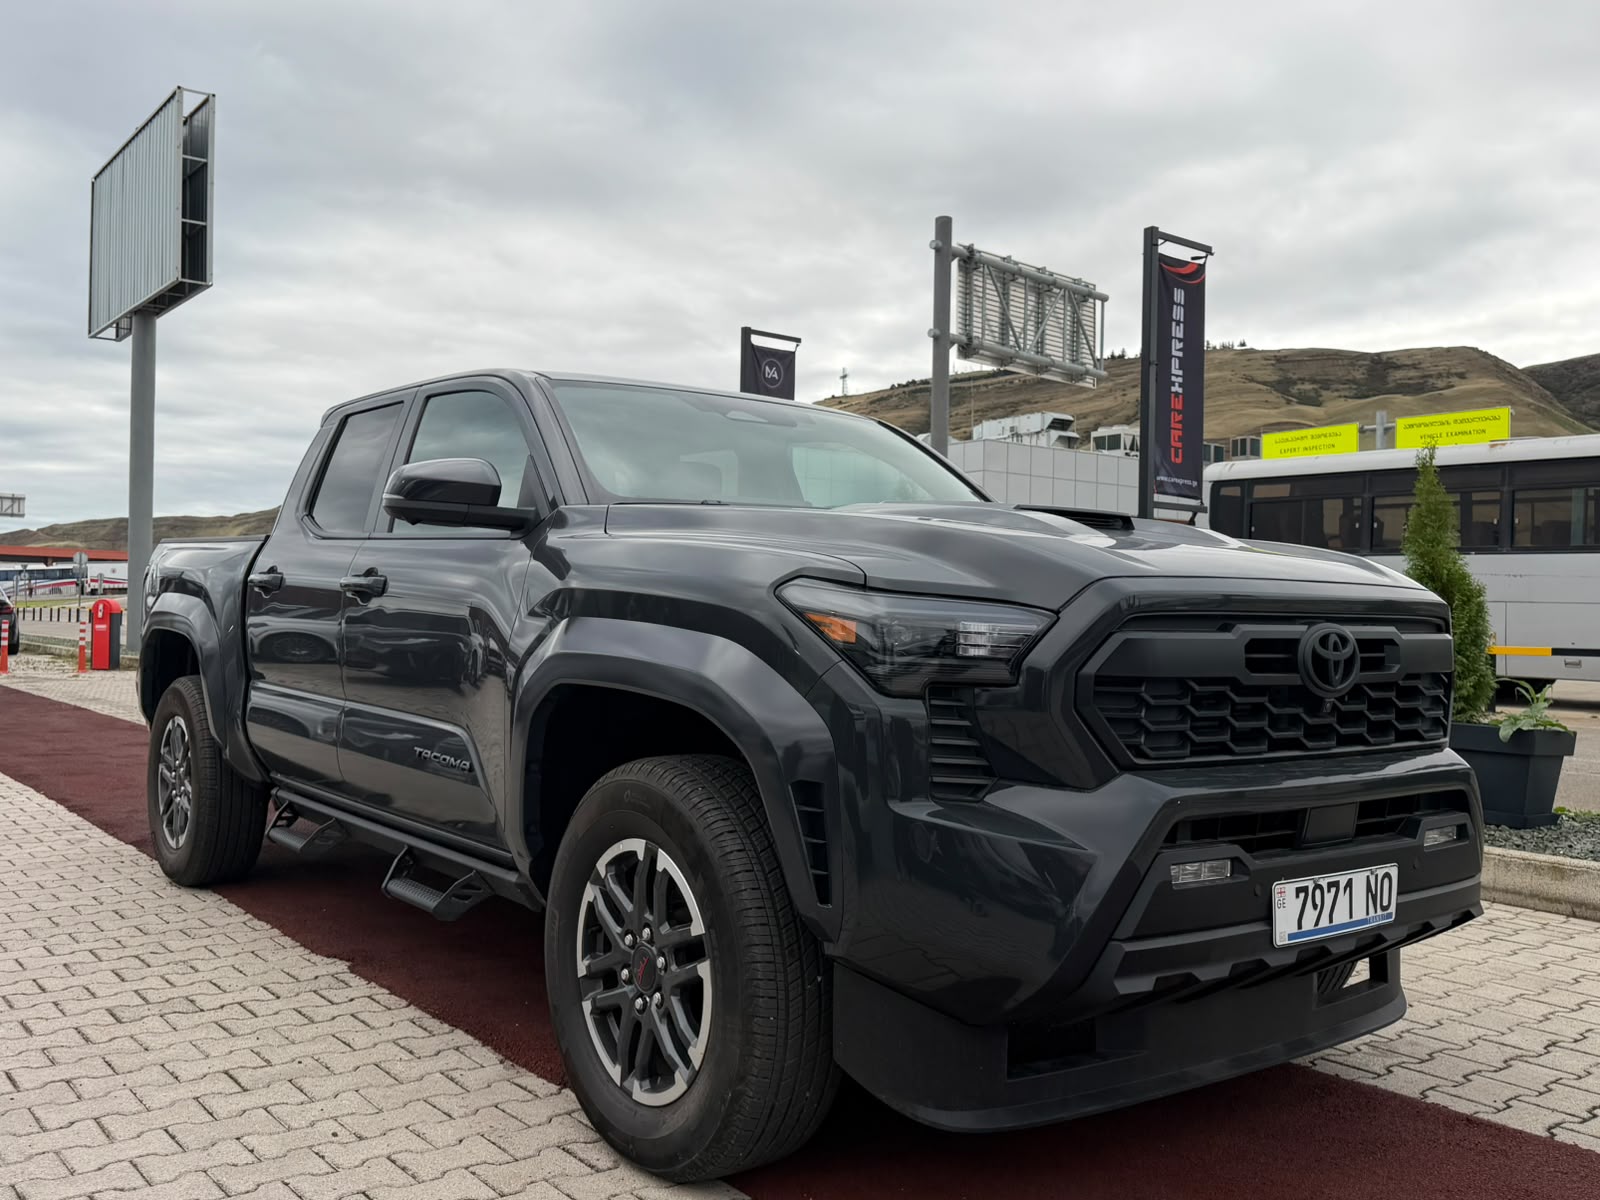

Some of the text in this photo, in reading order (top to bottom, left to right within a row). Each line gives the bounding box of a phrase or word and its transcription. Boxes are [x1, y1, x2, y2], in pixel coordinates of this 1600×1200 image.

[1170, 287, 1185, 464] CAREXPRESS
[1446, 428, 1487, 438] EXAMINATION
[1279, 443, 1336, 454] EXPERT INSPECTION
[413, 746, 472, 771] TACOMA
[1276, 898, 1286, 909] GE
[1295, 871, 1393, 931] 7971 NO
